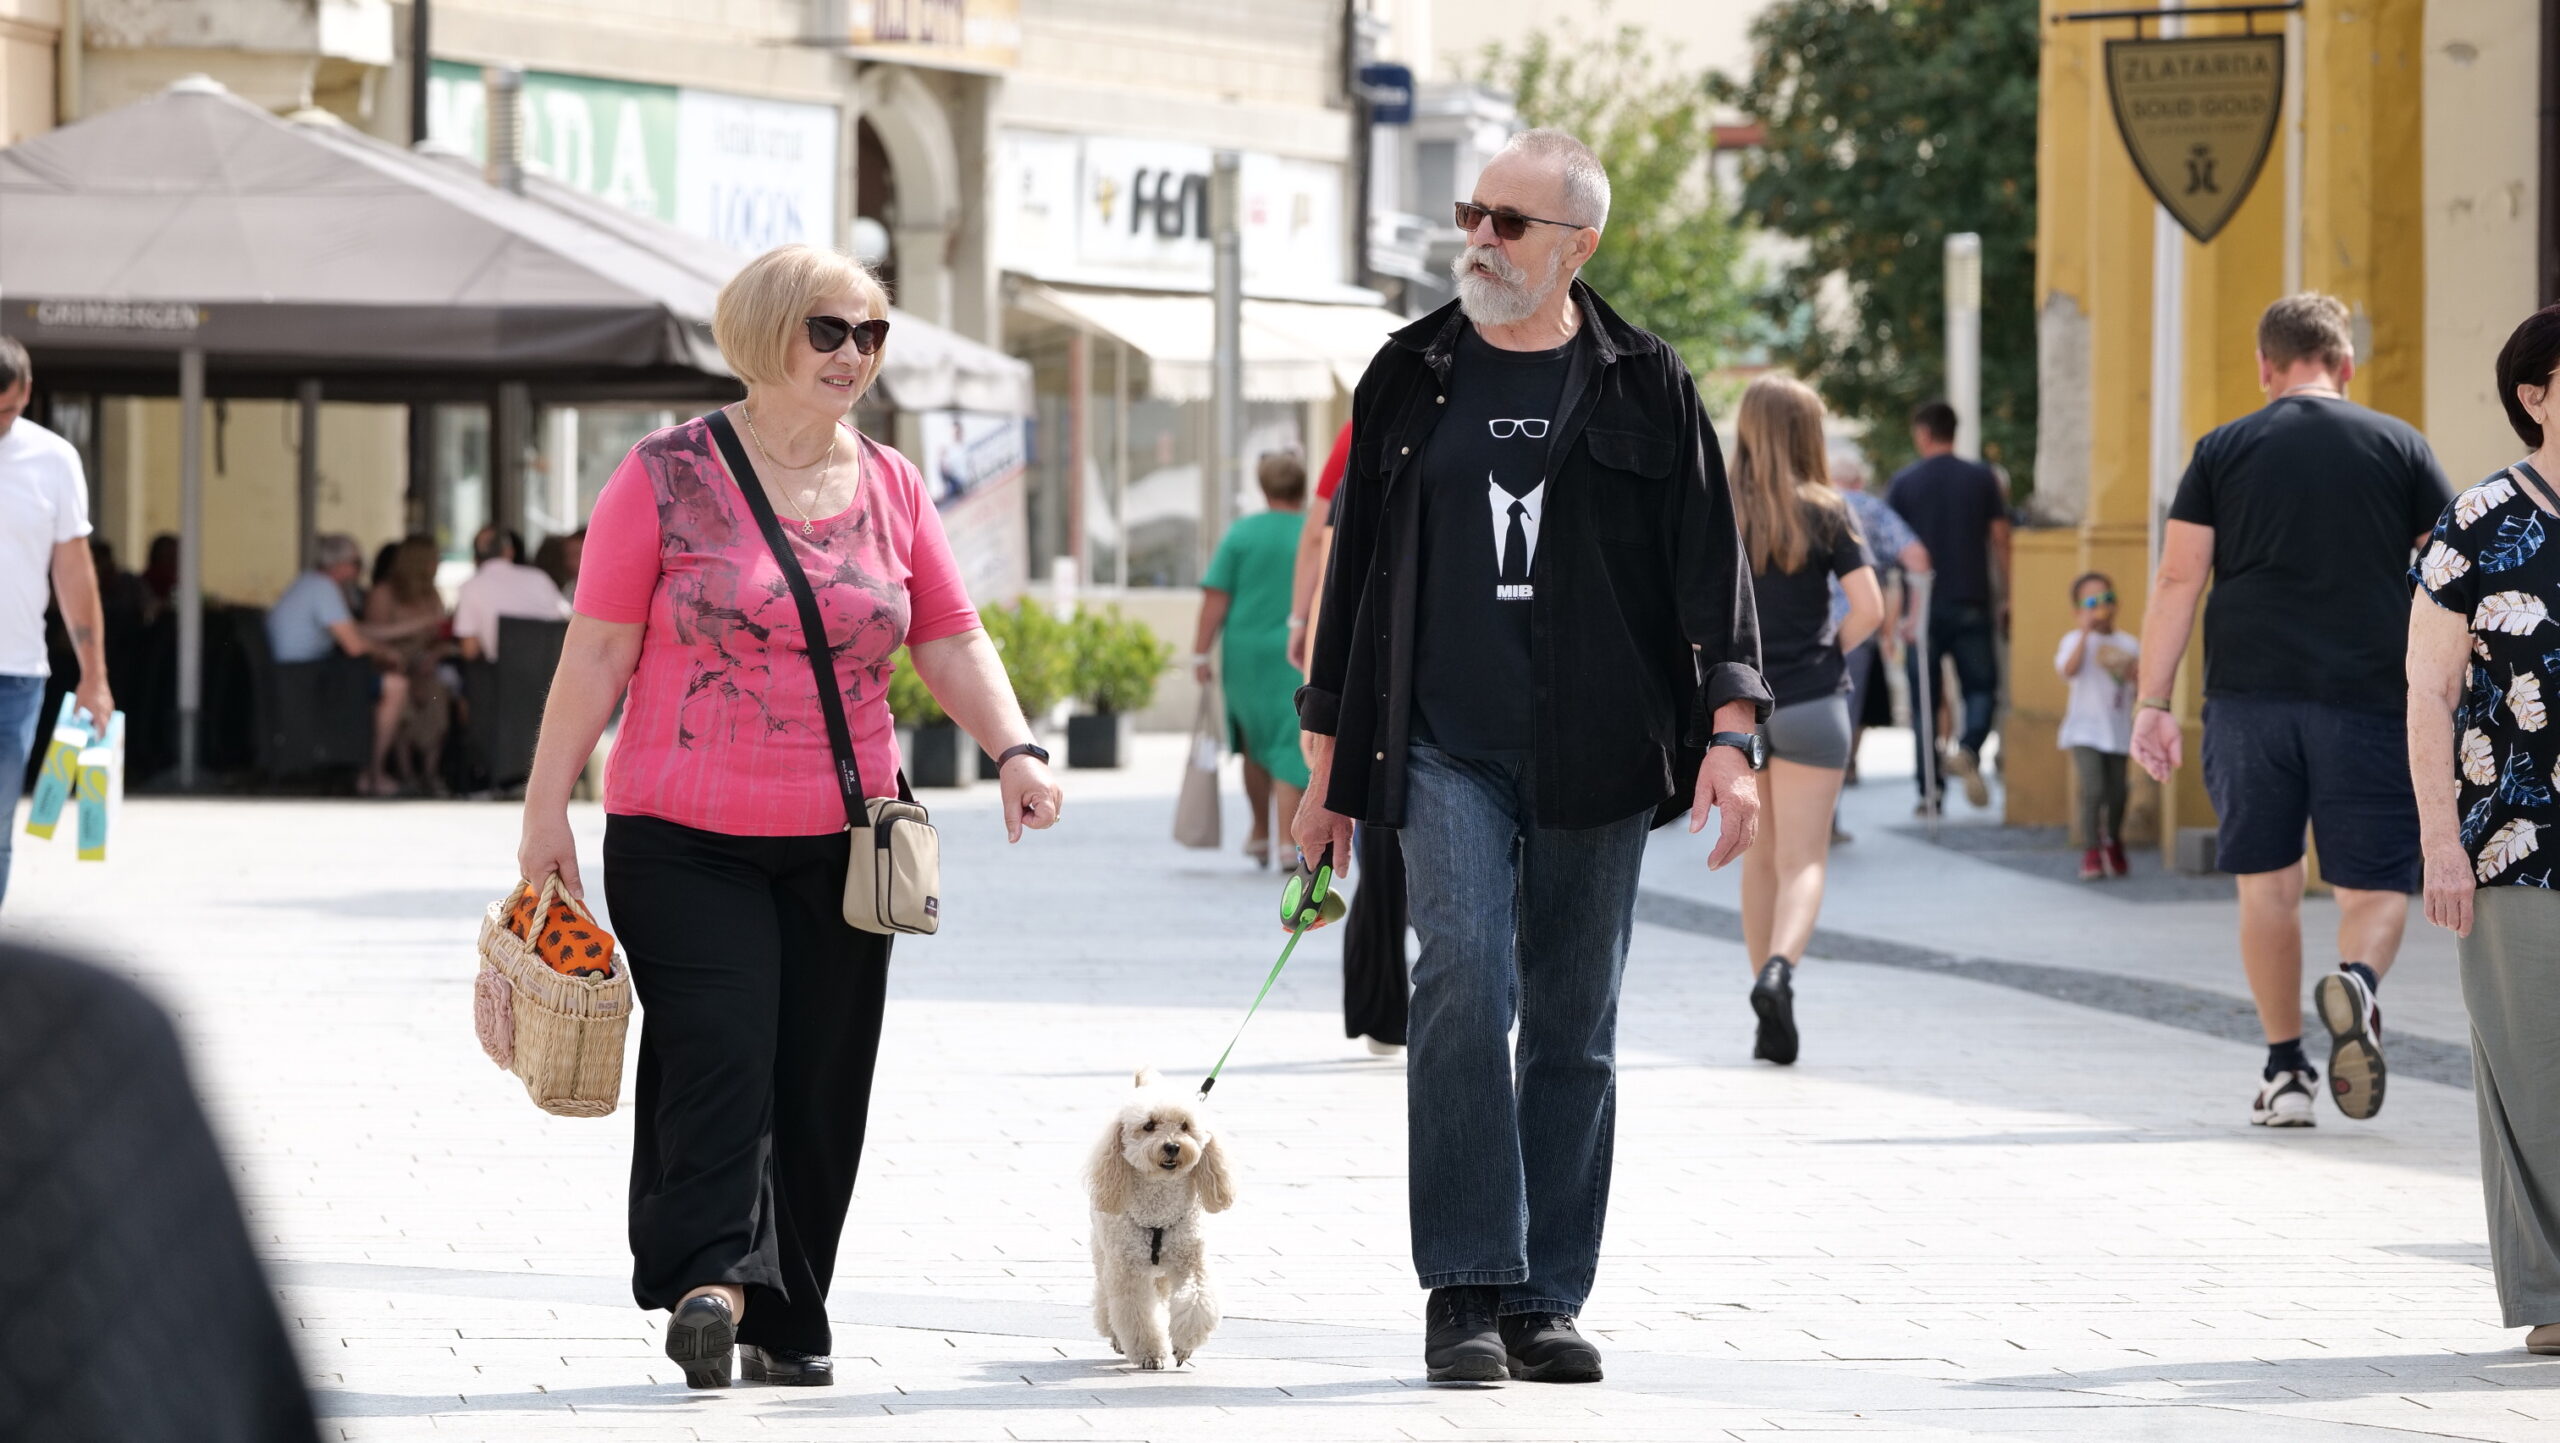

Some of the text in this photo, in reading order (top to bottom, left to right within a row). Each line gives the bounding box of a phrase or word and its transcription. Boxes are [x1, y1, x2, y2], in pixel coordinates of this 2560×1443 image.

[37, 300, 199, 330] GRIMBERGEN
[1496, 584, 1534, 597] MIB
[848, 769, 856, 783] PX
